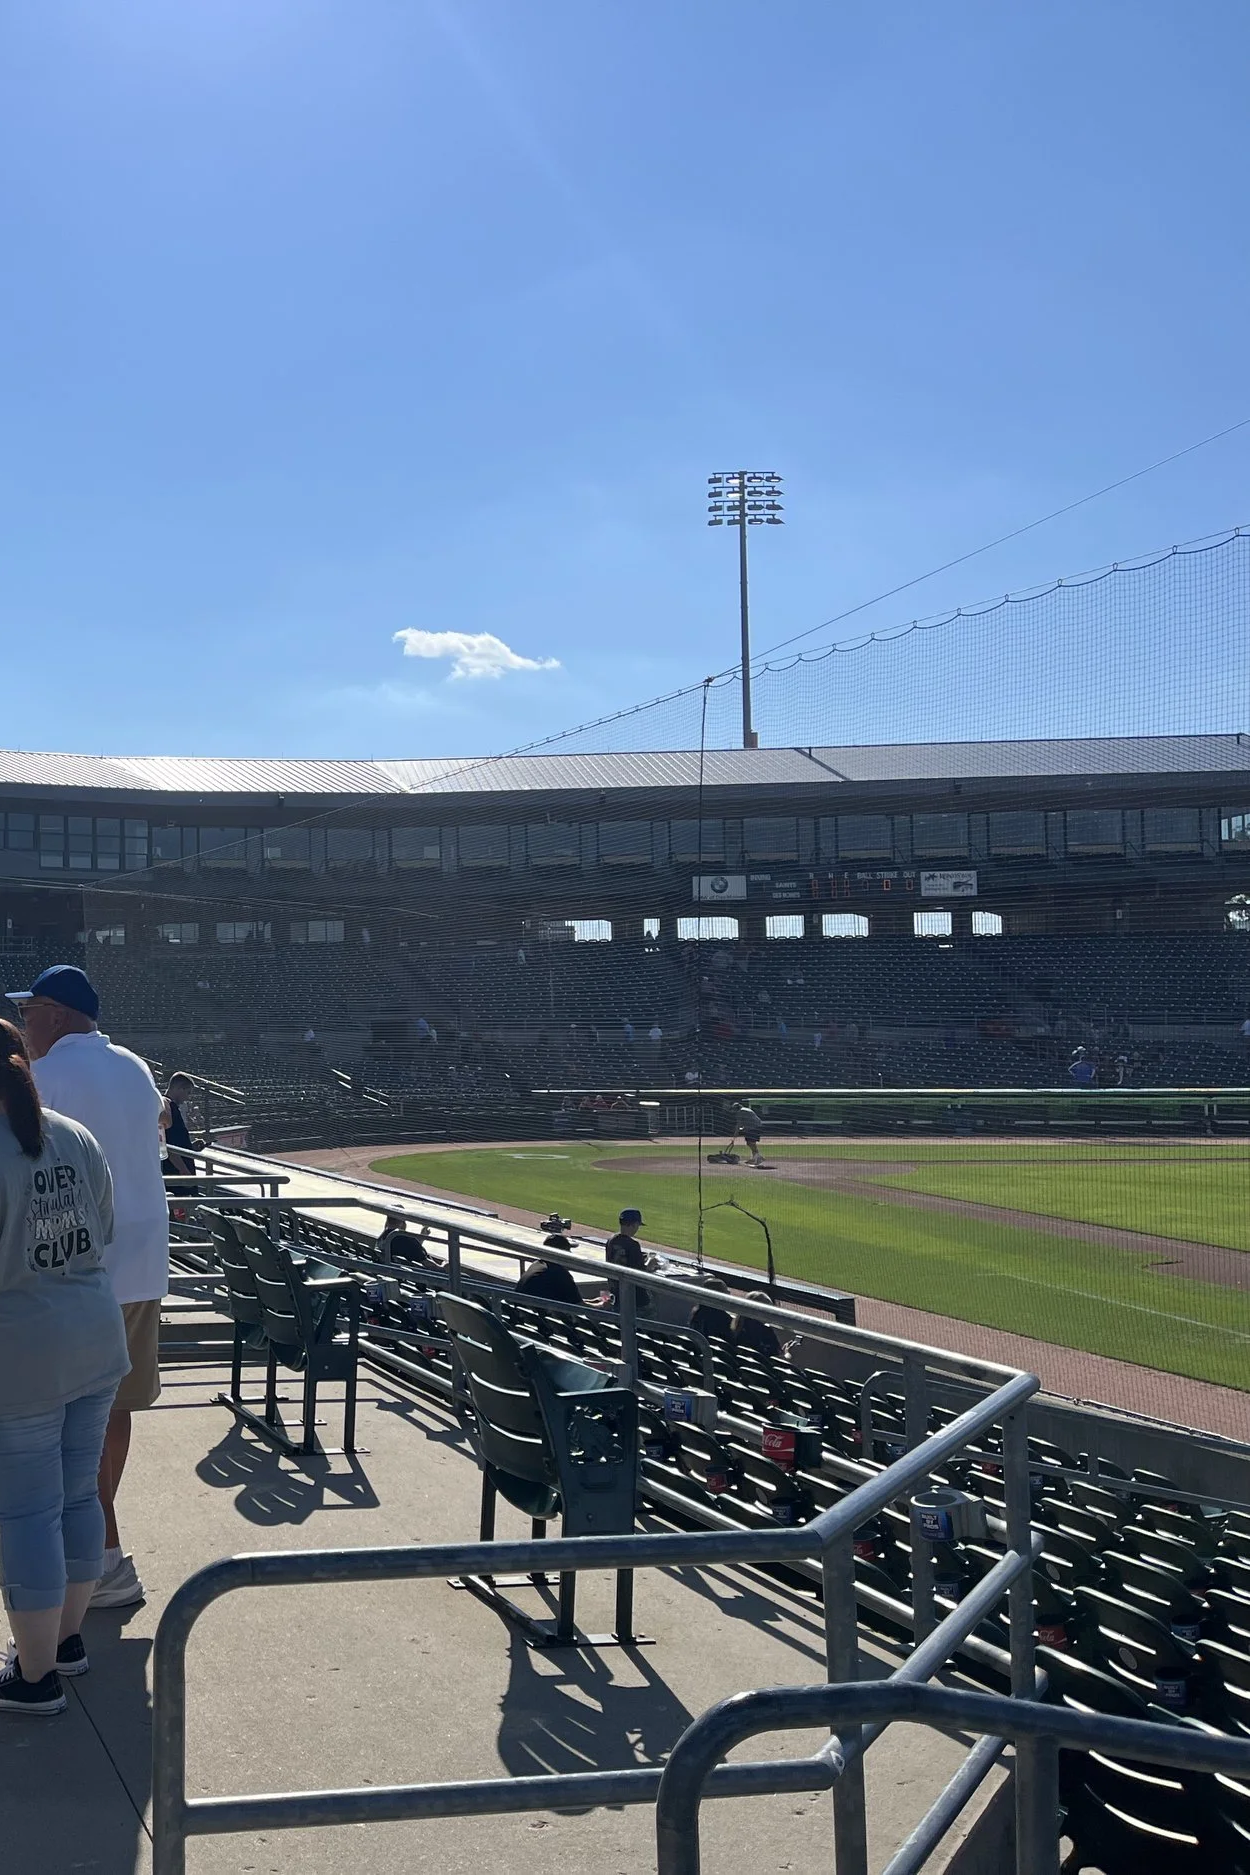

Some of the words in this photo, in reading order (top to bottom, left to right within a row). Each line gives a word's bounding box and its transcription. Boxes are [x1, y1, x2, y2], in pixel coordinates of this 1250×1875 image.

[876, 871, 898, 879] STRIKE
[34, 1165, 77, 1194] OVER
[35, 1208, 86, 1241] MOMS
[34, 1227, 91, 1268] CLUB
